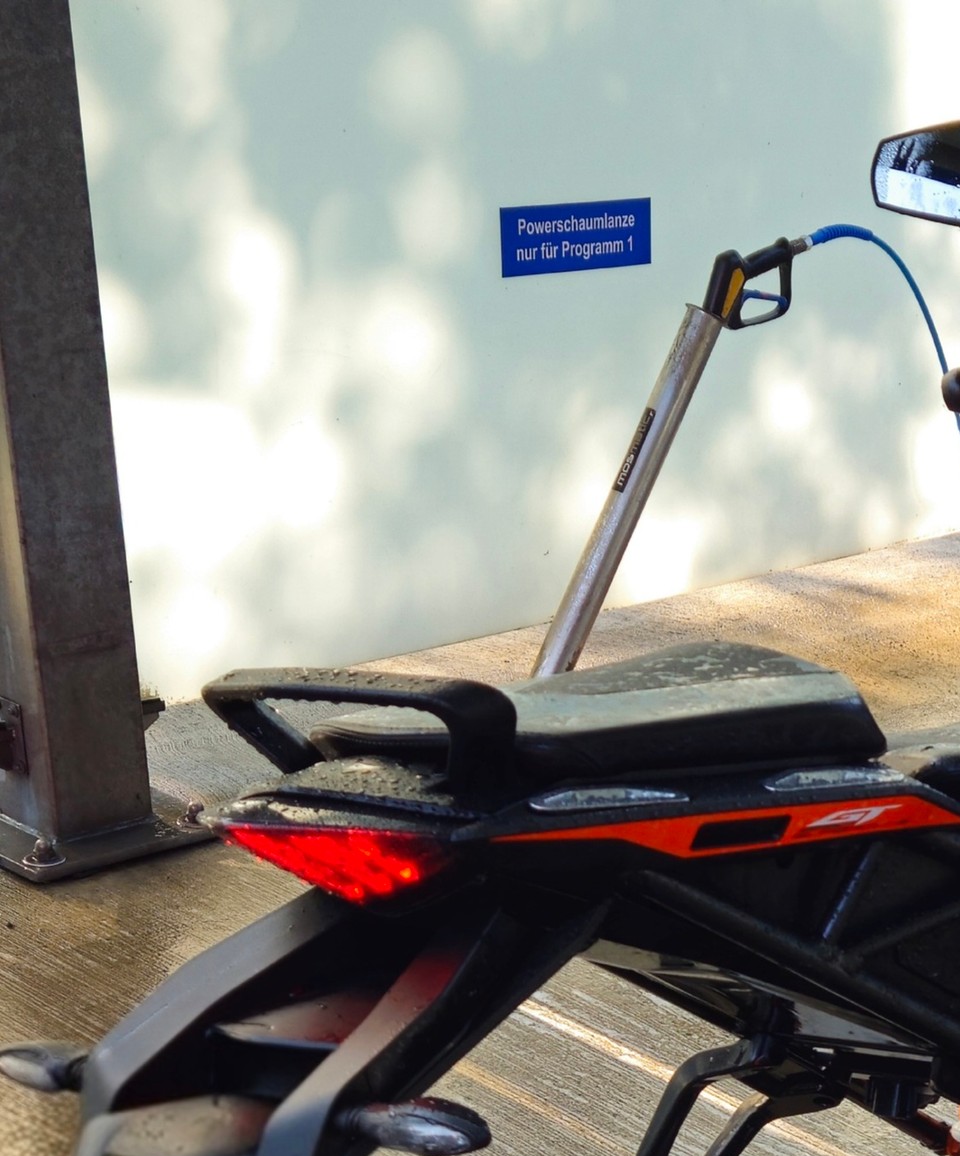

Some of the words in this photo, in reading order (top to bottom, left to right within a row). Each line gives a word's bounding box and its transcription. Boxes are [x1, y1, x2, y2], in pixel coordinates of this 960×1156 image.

[518, 213, 635, 235] Powerschaumlanze
[516, 246, 537, 262] nur
[540, 242, 558, 259] für
[562, 239, 624, 260] Programm
[627, 235, 633, 251] 1
[806, 804, 903, 828] GT
